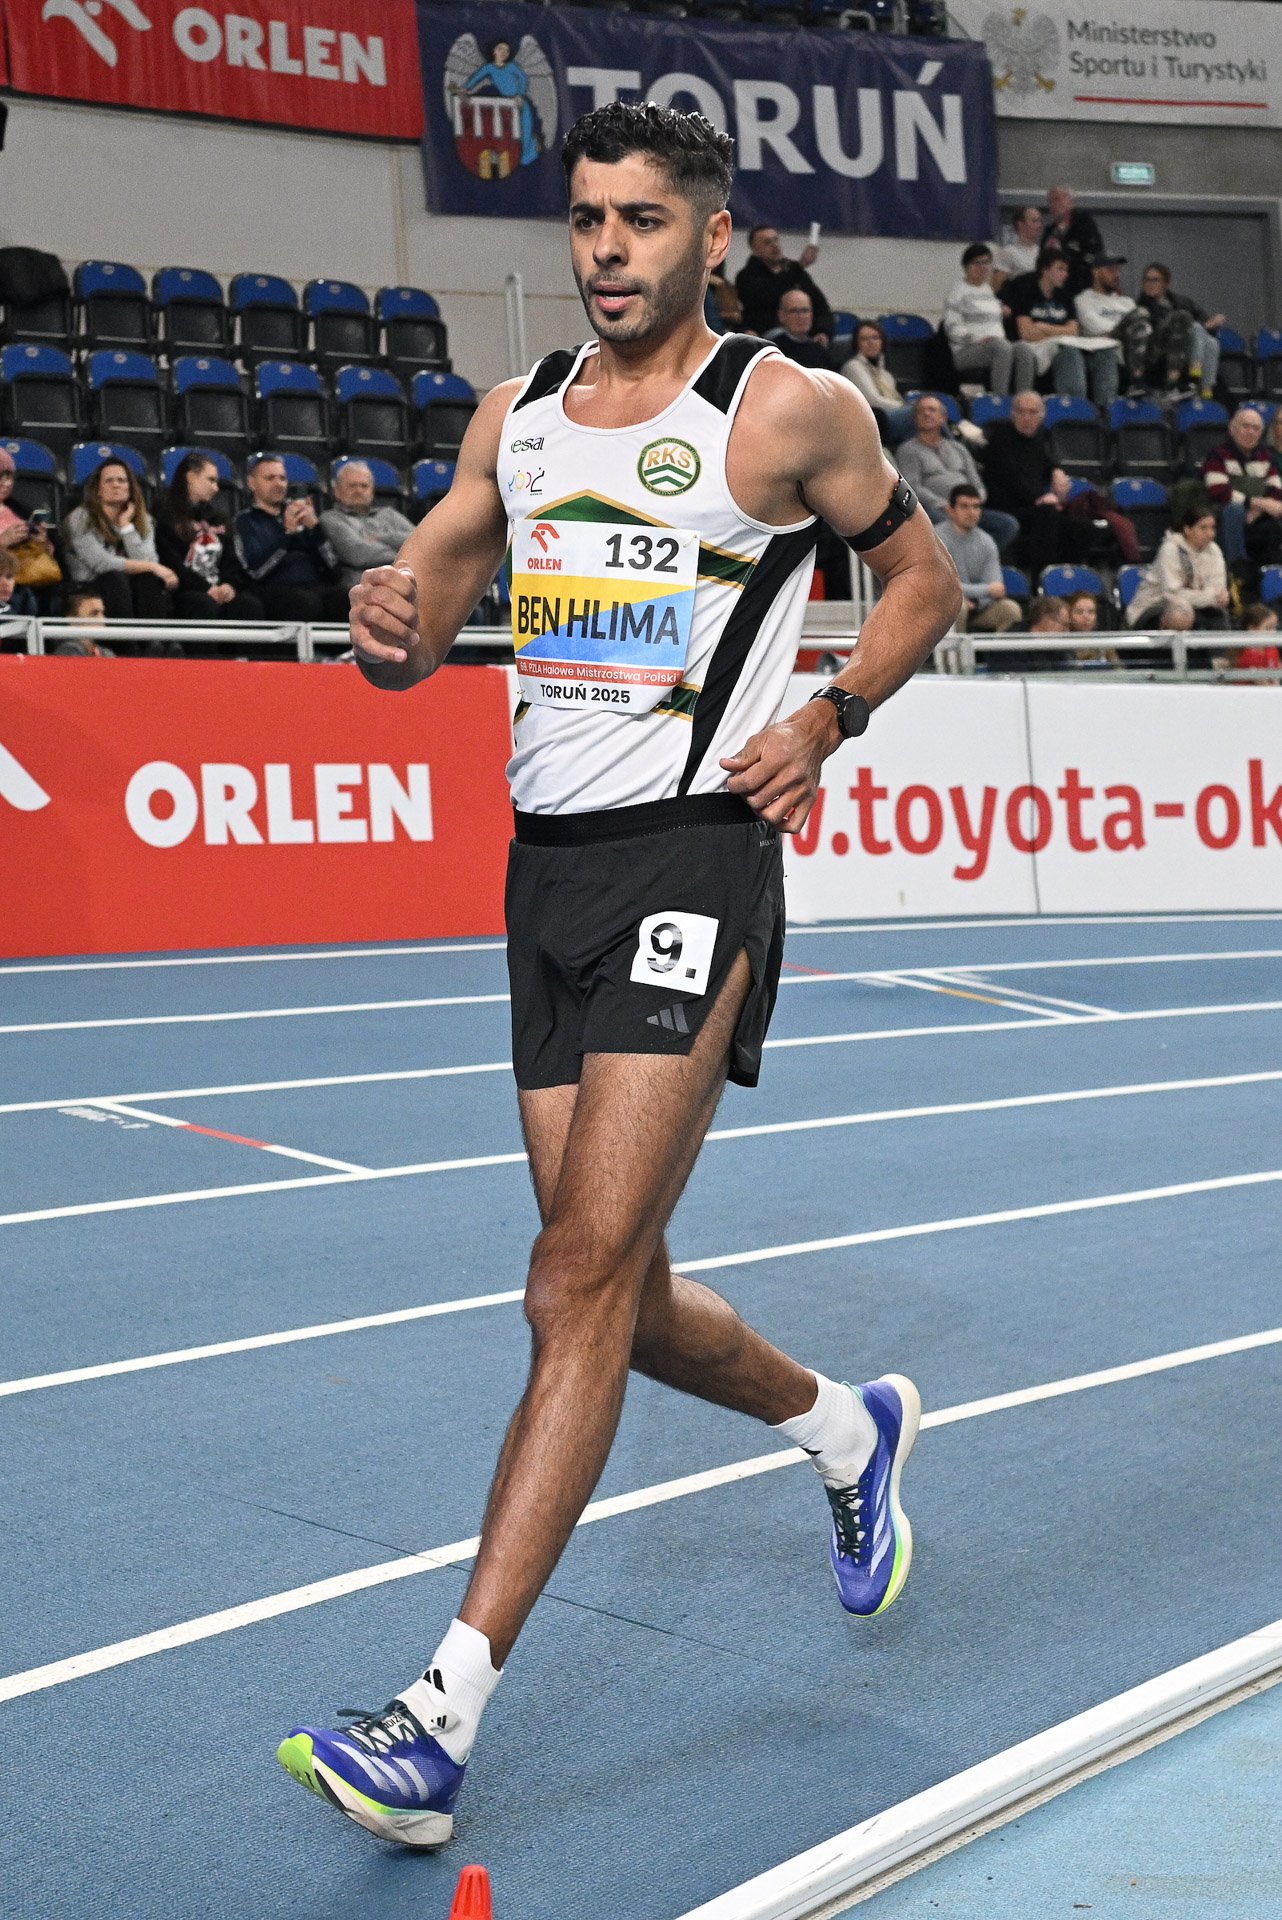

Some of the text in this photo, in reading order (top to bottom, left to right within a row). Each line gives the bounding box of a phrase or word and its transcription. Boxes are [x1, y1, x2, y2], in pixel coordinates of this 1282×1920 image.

[173, 7, 388, 87] ORLEN
[1066, 19, 1217, 49] Ministerstwo
[1069, 51, 1268, 84] Sportu i Turystyki
[647, 445, 692, 469] RKS
[527, 557, 562, 571] ORLEN
[605, 533, 680, 574] 132
[518, 595, 680, 646] BEN HLIMA
[529, 663, 542, 673] PZLA
[542, 664, 575, 676] Halowe
[576, 667, 641, 682] Mistrzostwa
[643, 672, 677, 683] Polski
[540, 683, 631, 704] TORUŃ 2025
[125, 760, 434, 848] ORLEN
